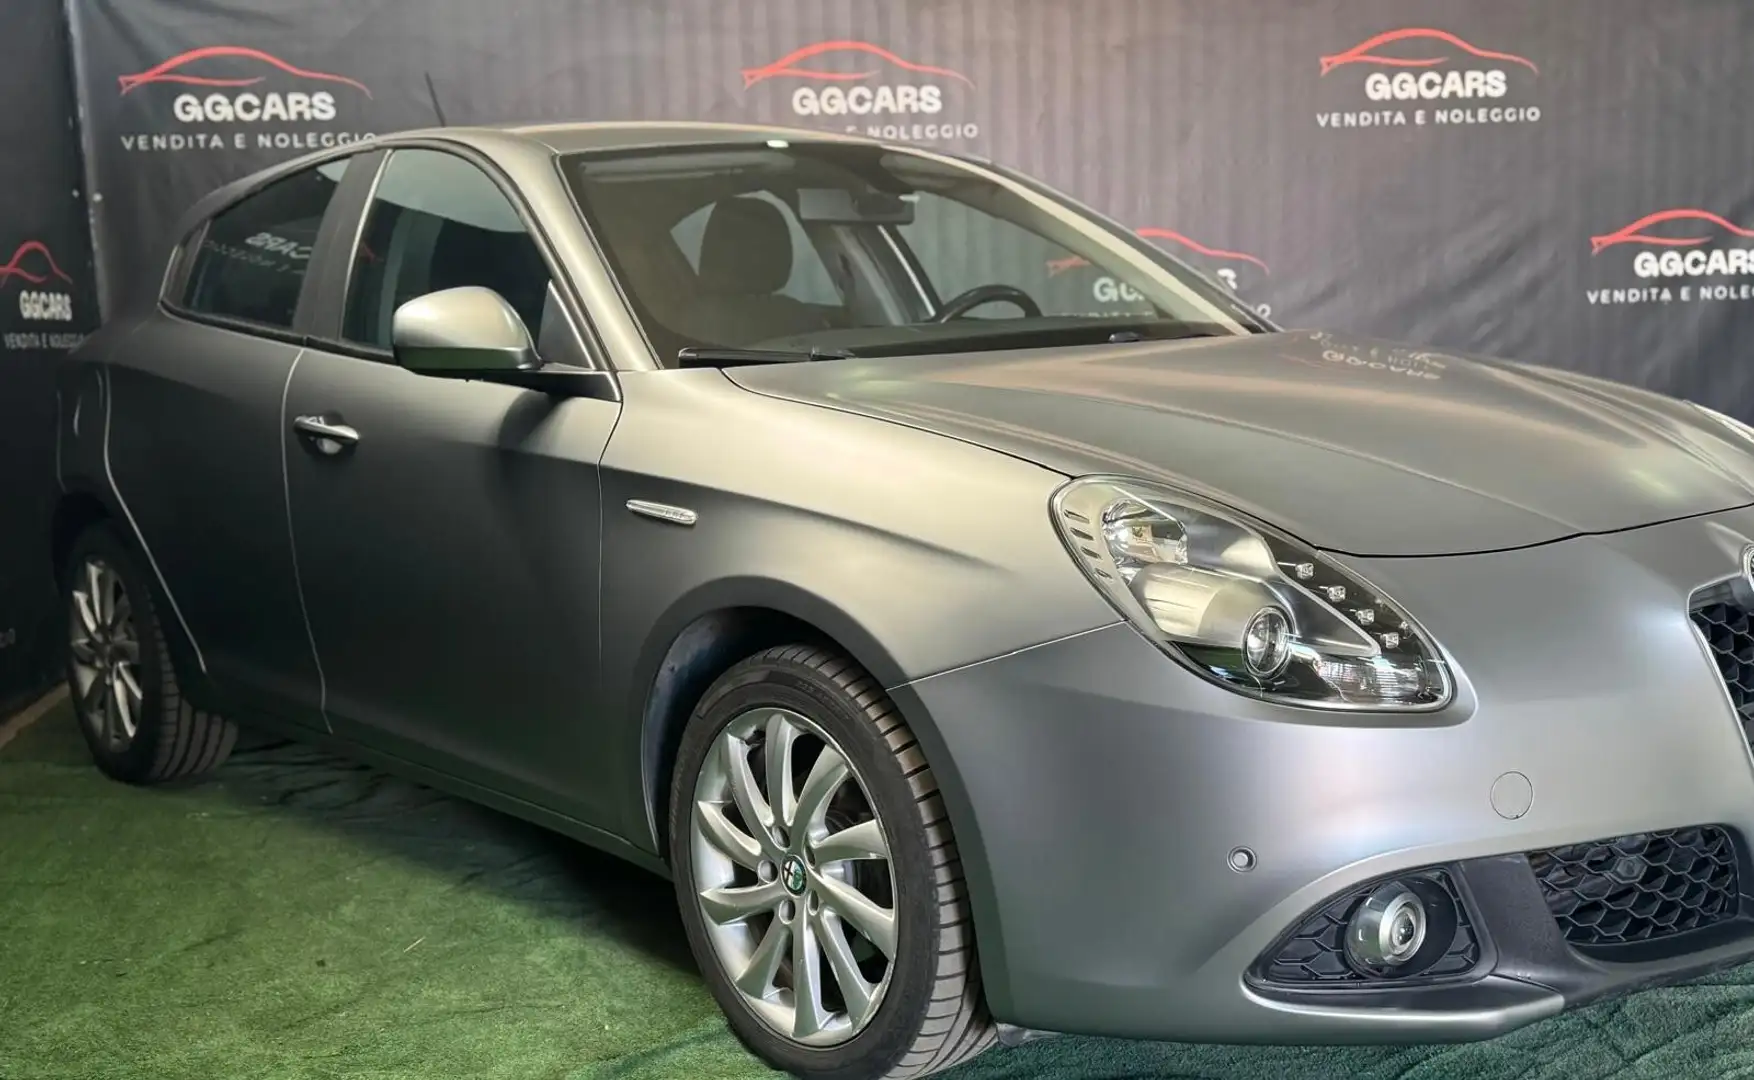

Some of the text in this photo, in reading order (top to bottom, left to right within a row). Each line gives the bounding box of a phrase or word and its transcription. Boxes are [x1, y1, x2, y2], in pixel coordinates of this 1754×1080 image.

[791, 84, 943, 116] GGCARS
[1365, 69, 1508, 101] GGCARS
[173, 91, 336, 122] GGCARS
[1316, 106, 1541, 128] VENDITA E NOLEGGIO
[120, 132, 224, 151] VENDITA
[234, 133, 247, 149] E
[866, 123, 979, 140] NOLEGGIO
[1633, 248, 1754, 278] GGCAR
[19, 289, 73, 321] GGCARS
[1586, 283, 1754, 305] VENDITA E NOLE
